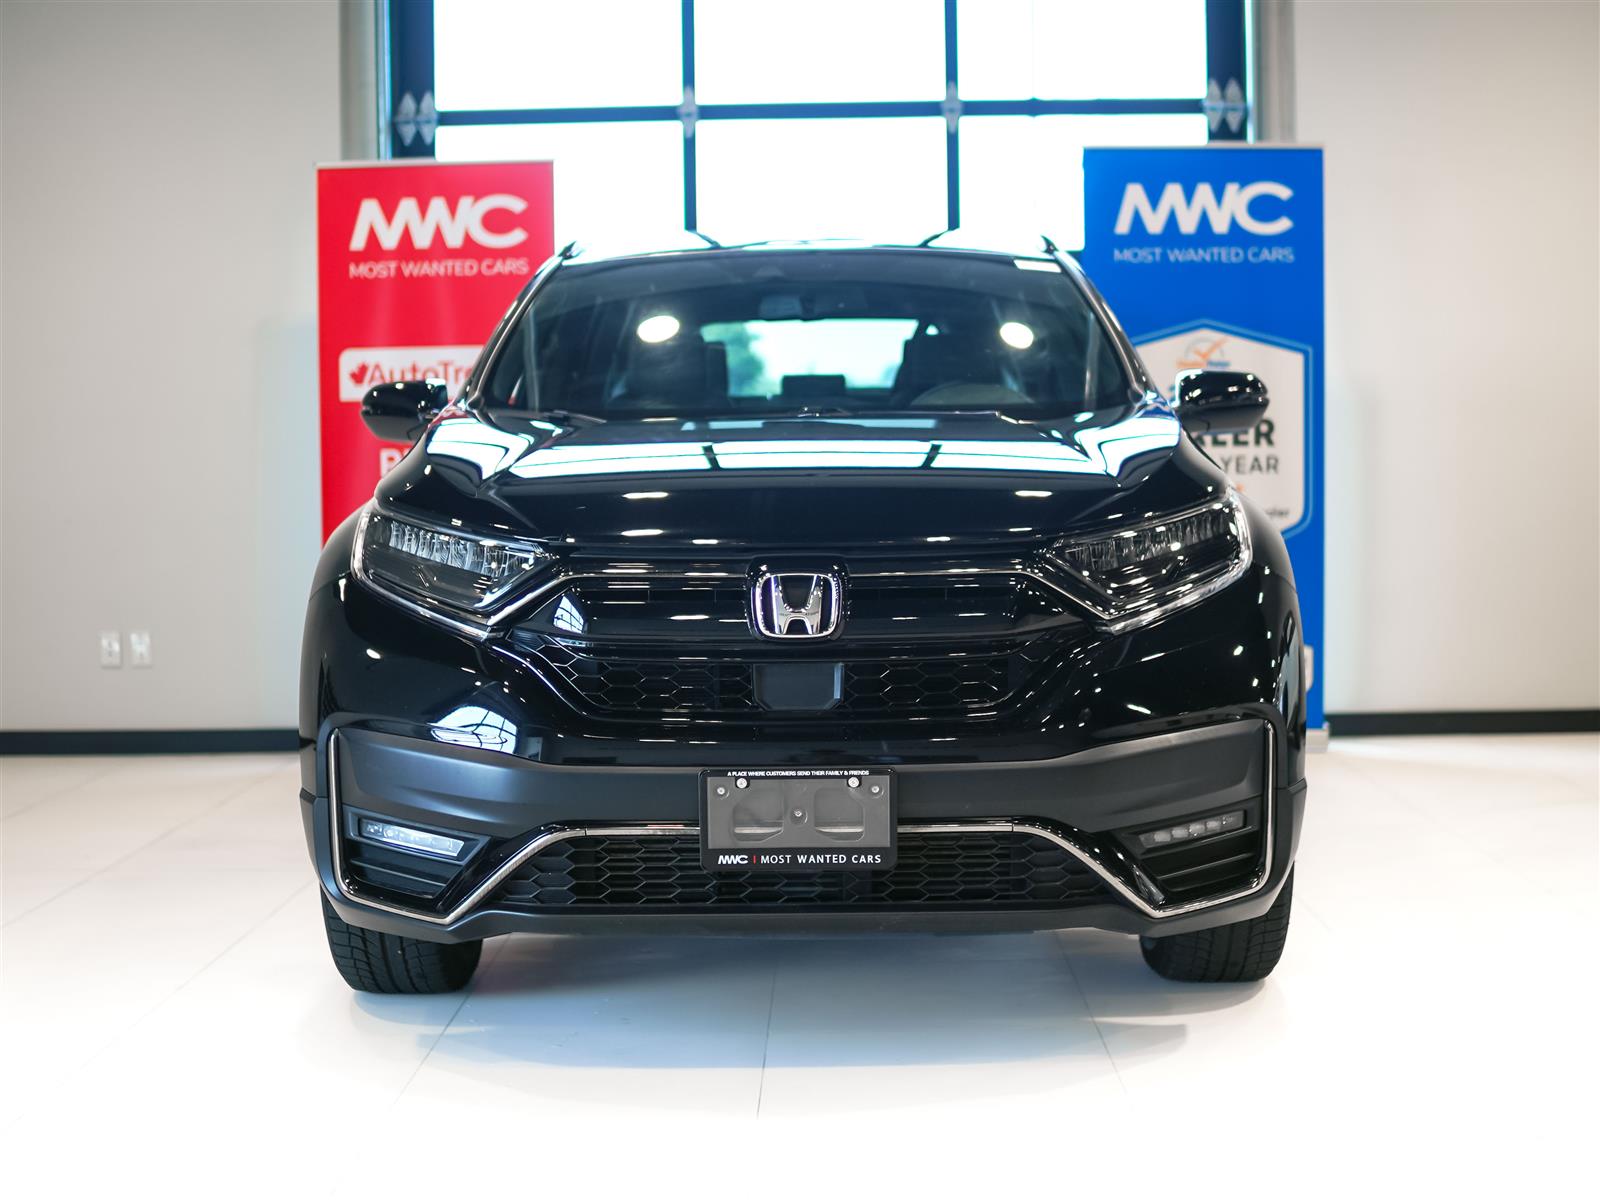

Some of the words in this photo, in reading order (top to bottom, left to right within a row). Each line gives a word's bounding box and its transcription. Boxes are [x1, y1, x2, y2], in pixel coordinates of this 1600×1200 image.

[1114, 181, 1294, 236] MWC
[349, 193, 528, 251] MWC
[1113, 247, 1162, 263] MOST
[1167, 247, 1244, 263] WANTED
[1248, 247, 1295, 263] CARS
[349, 261, 398, 279] MOST
[400, 259, 478, 277] WANTED
[481, 257, 529, 275] CARS
[1220, 454, 1279, 474] YEAR
[717, 855, 749, 865] MWC
[760, 855, 792, 864] MOST
[797, 854, 847, 864] WANTED
[851, 854, 882, 863] CARS
